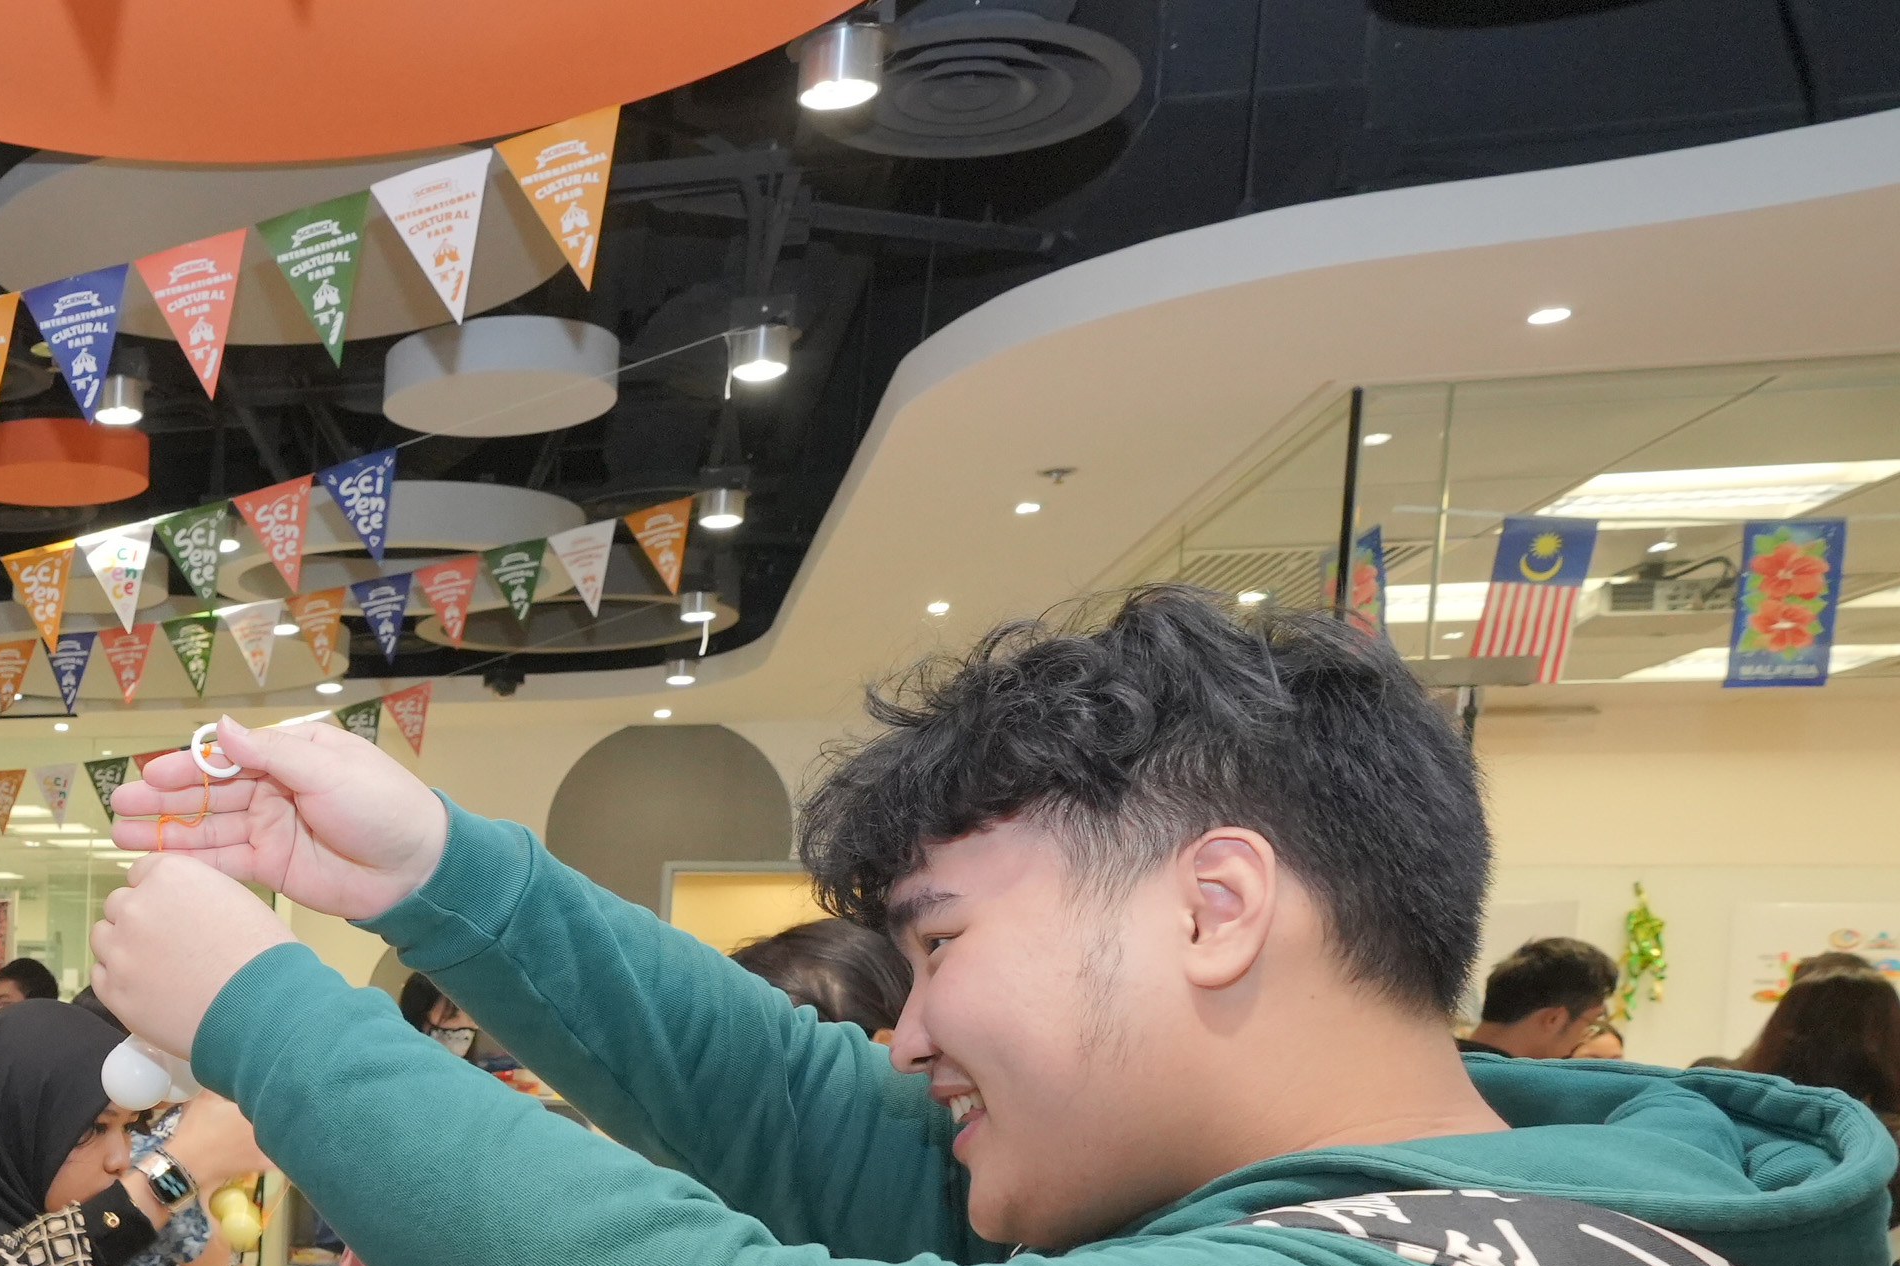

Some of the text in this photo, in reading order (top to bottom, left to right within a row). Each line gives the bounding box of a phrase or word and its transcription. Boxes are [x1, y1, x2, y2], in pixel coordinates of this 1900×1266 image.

[535, 171, 600, 200] CULTURAL
[553, 187, 584, 204] FAIR
[408, 209, 470, 236] CULTURAL
[426, 224, 455, 239] FAIR
[290, 250, 352, 278] CULTURAL
[308, 265, 336, 282] FAIR
[166, 289, 226, 313] CULTURAL
[183, 303, 211, 318] FAIR
[51, 322, 109, 345] CULTURAL
[67, 335, 95, 350] FAIR
